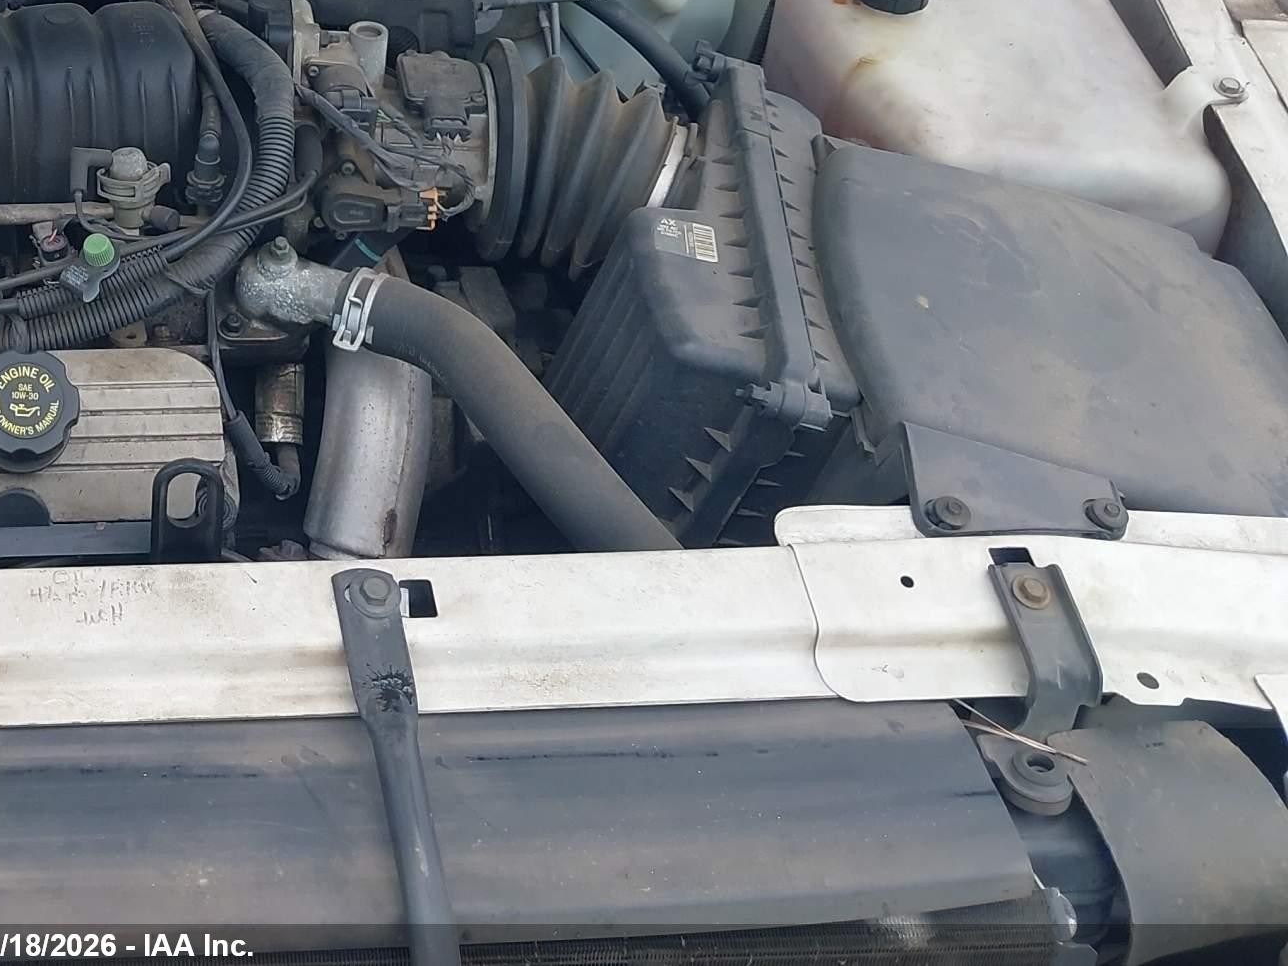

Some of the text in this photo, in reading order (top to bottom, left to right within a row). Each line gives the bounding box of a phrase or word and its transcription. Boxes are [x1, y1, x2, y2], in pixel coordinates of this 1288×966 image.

[18, 383, 33, 392] SAE
[39, 374, 55, 393] OIL
[12, 392, 39, 400] 10W-30
[35, 400, 60, 433] MANUAL
